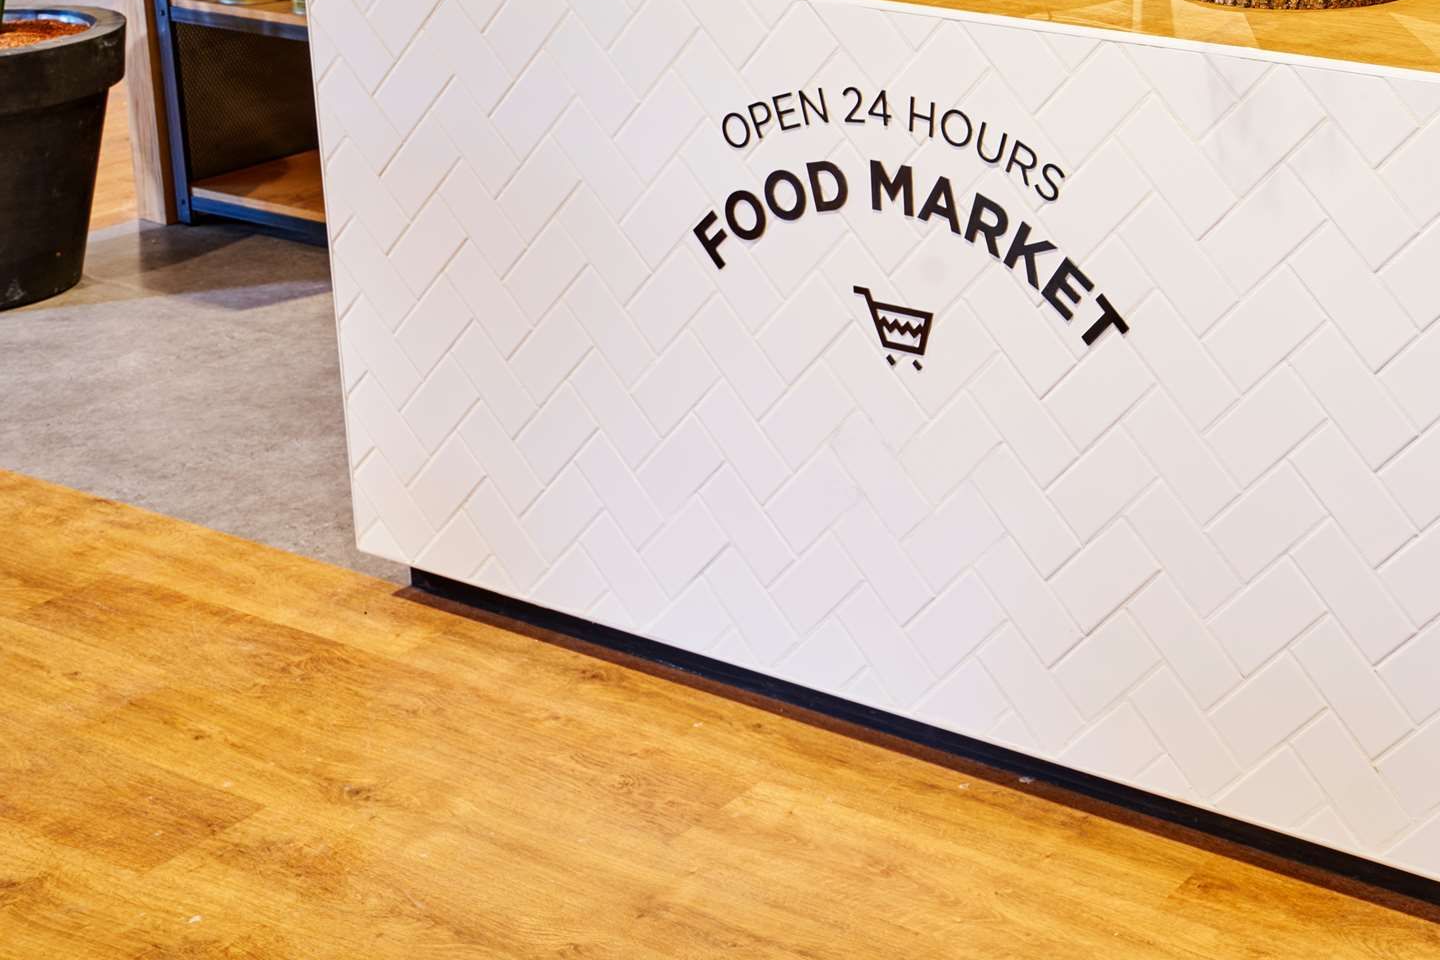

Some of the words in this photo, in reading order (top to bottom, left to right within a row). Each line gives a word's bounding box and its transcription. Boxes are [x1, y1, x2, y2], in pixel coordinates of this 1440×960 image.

[722, 87, 829, 149] OPEN
[842, 86, 892, 127] 24
[908, 96, 1066, 202] HOURS
[693, 160, 849, 270] FOOD
[869, 159, 1130, 347] MARKET
